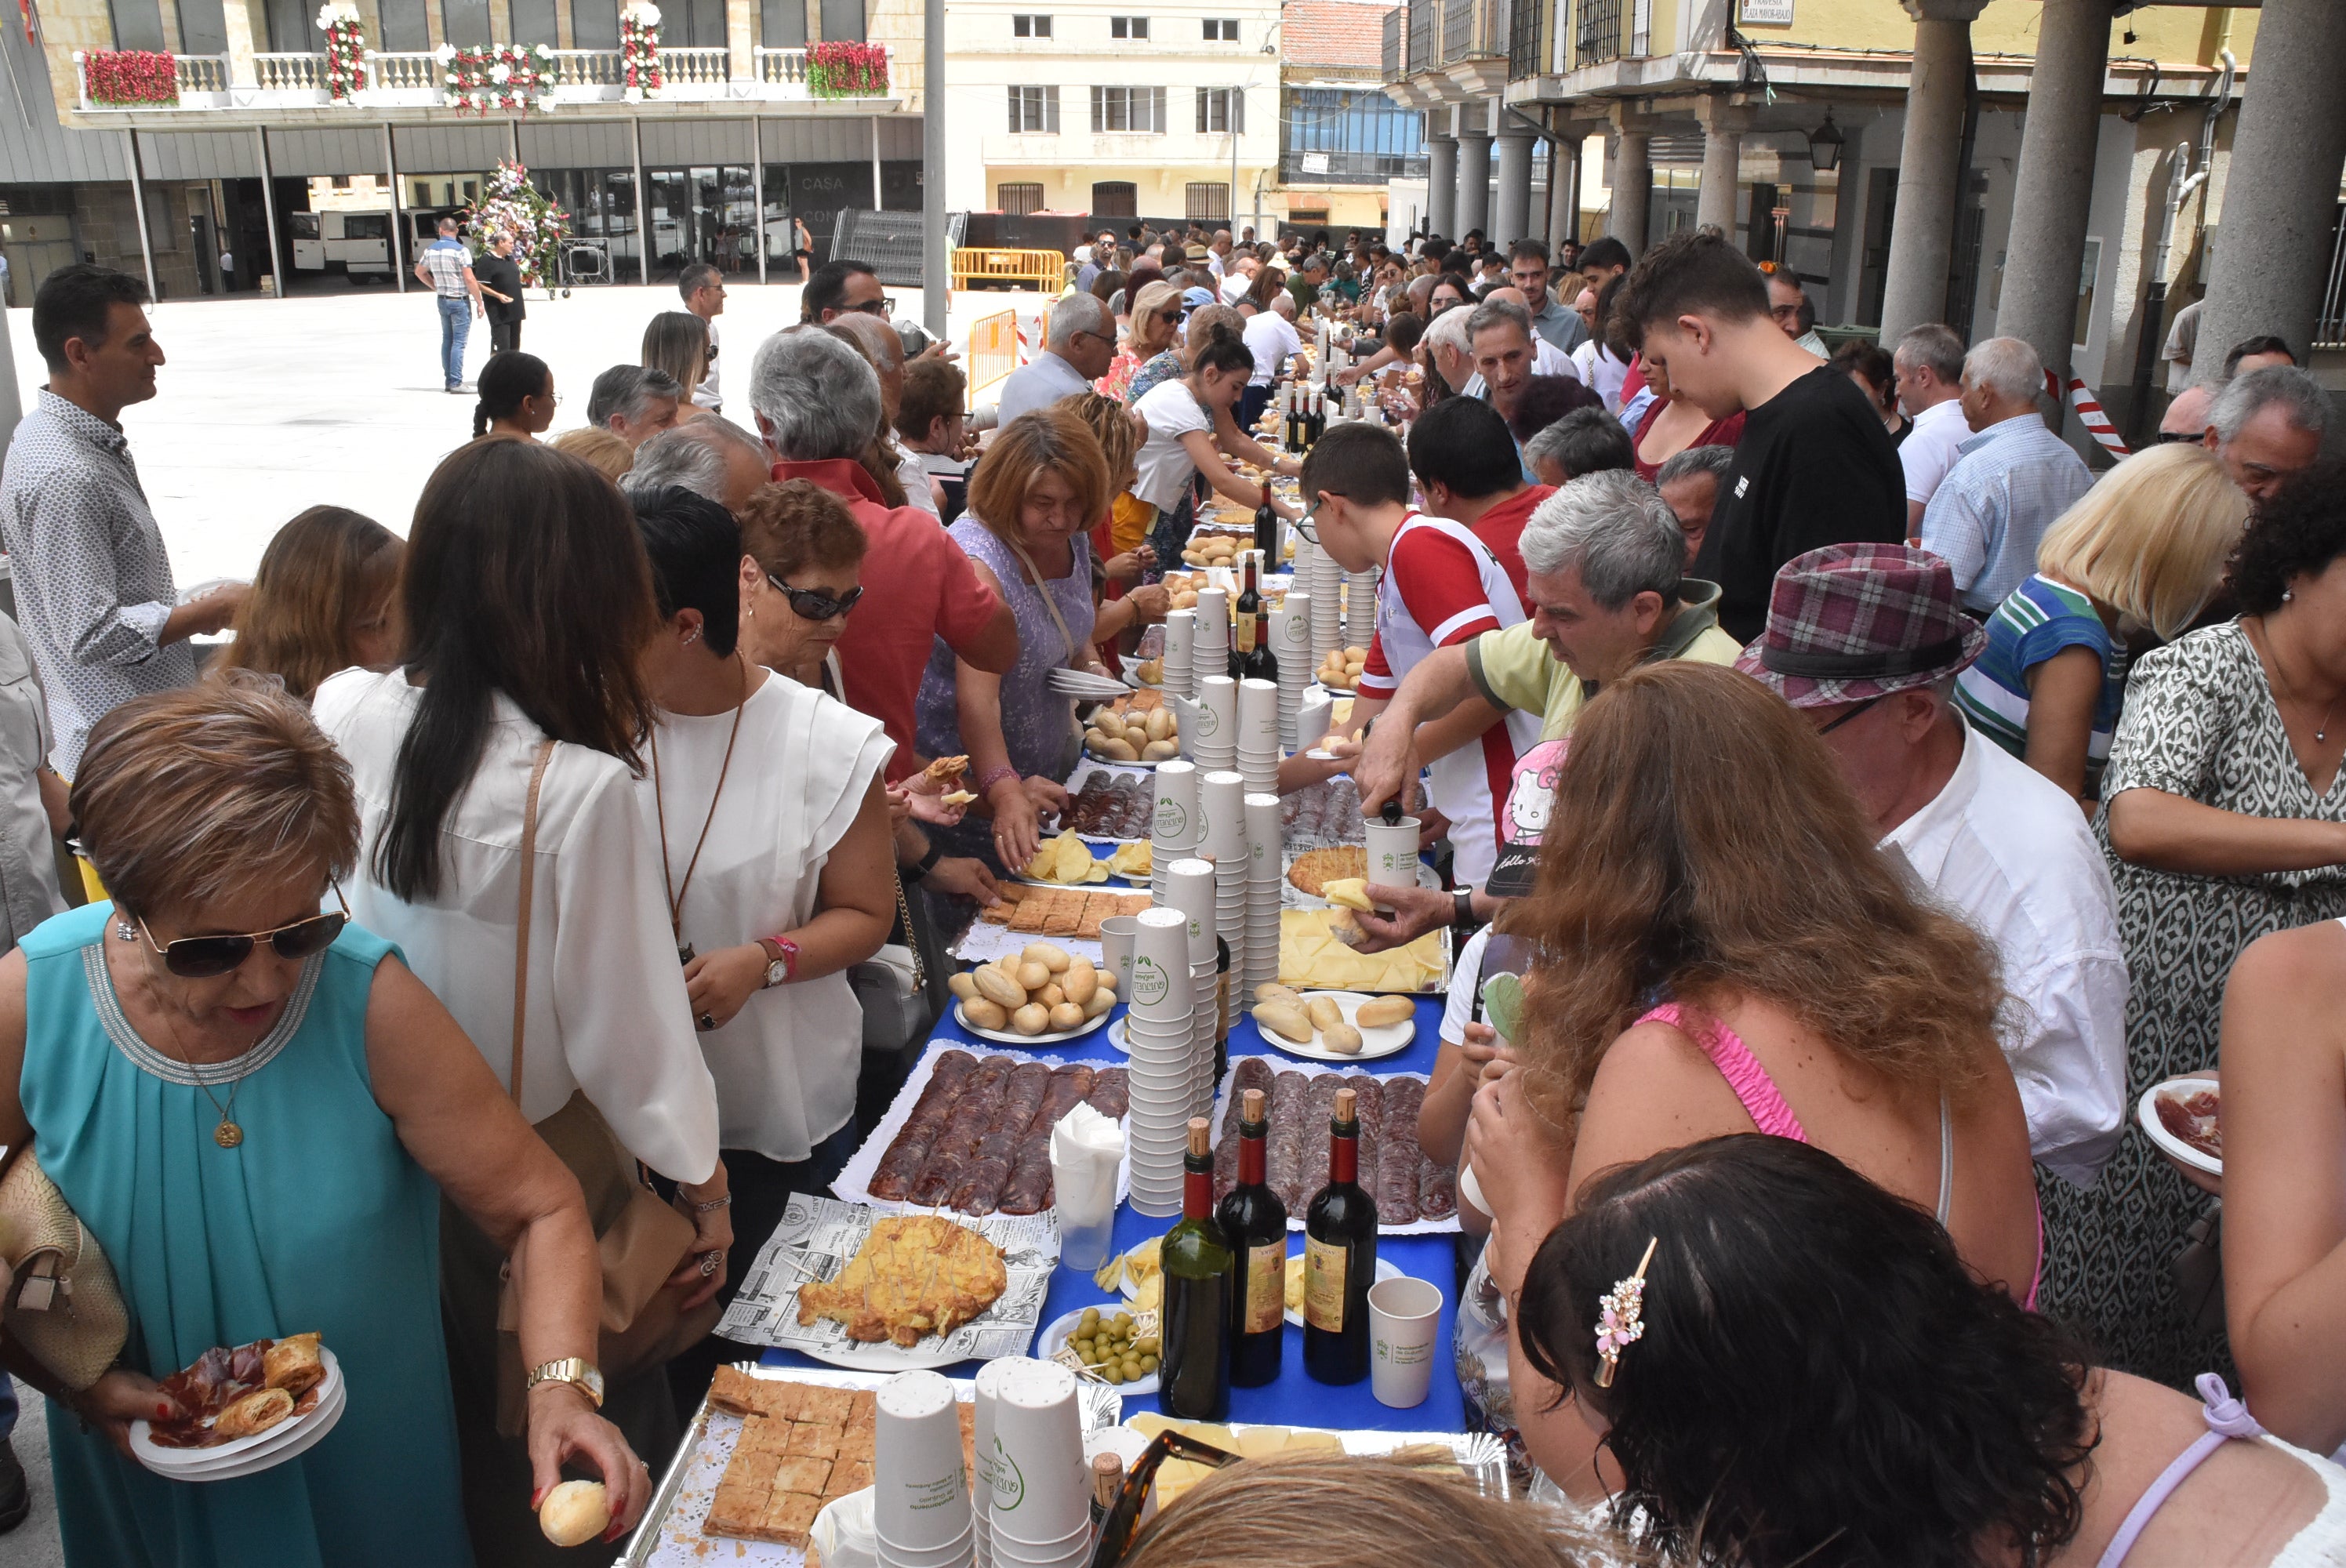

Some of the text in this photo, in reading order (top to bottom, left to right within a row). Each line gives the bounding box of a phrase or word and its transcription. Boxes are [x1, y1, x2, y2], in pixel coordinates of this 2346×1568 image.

[1744, 8, 1758, 19] PLAZA
[802, 177, 844, 191] CASA
[910, 1494, 955, 1511] Ayuntamiento
[919, 1492, 946, 1503] Guijuelo
